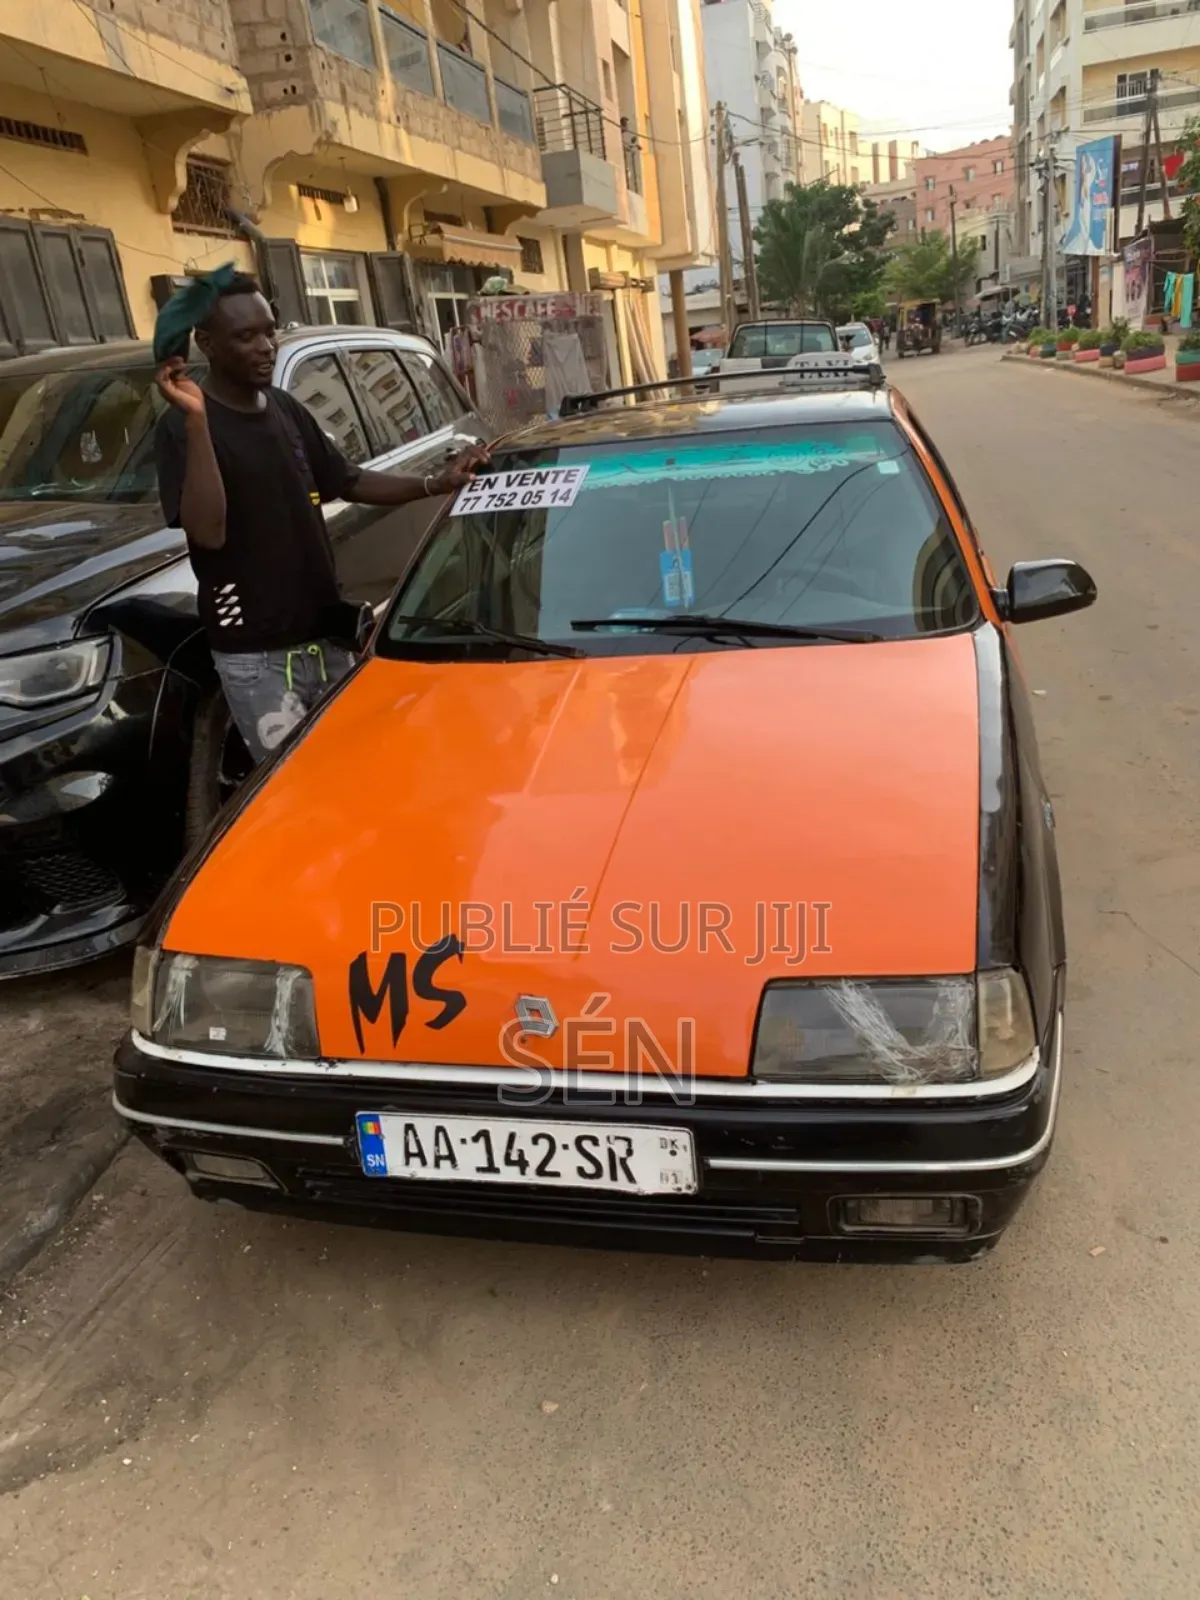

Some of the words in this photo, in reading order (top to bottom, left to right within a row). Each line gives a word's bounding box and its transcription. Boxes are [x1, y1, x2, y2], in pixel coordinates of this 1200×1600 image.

[795, 360, 849, 378] TAXI
[467, 476, 499, 493] EN
[505, 468, 580, 488] VENTE
[459, 496, 482, 512] 77
[484, 491, 517, 508] 752
[520, 489, 544, 506] 05
[550, 487, 572, 504] 14
[348, 934, 467, 1055] MS
[366, 1153, 386, 1168] SN
